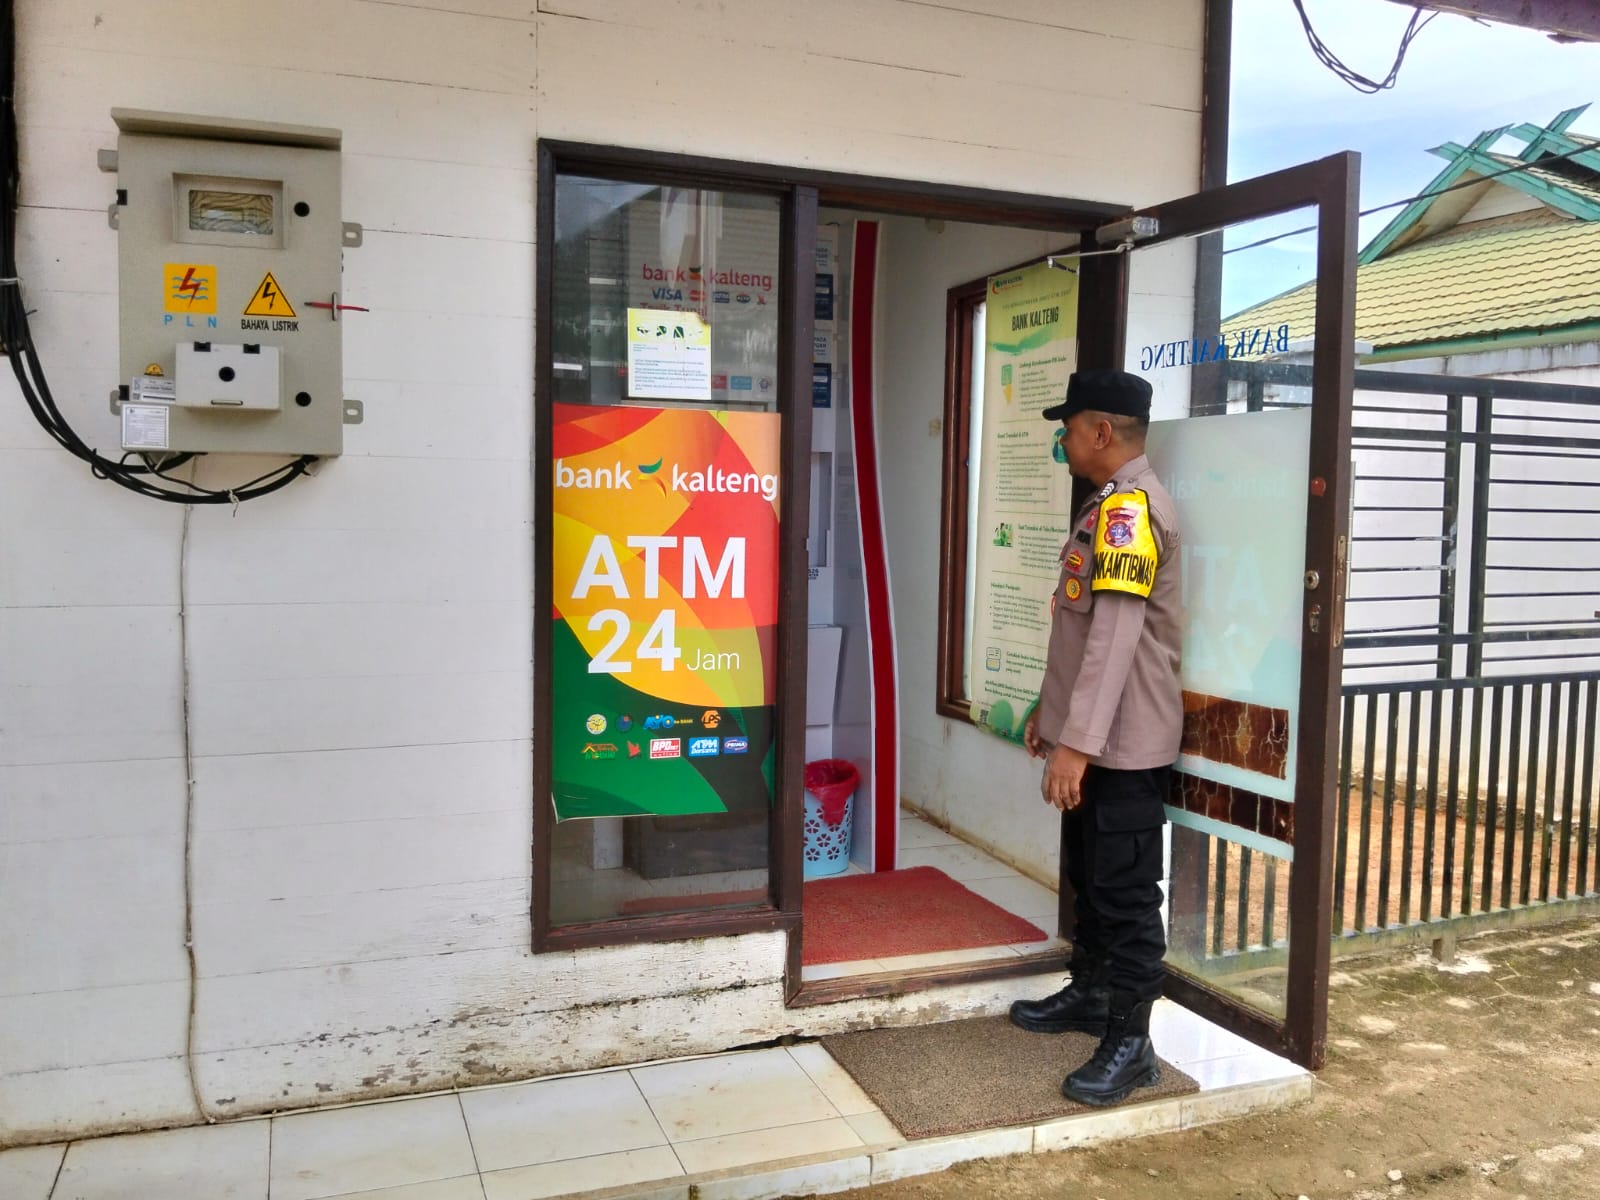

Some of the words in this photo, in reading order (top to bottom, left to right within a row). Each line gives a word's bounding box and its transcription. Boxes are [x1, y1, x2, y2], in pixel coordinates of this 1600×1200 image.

[643, 264, 685, 281] bank
[709, 267, 772, 292] kalteng
[652, 287, 683, 301] VISA
[241, 319, 269, 330] BAHAYA
[272, 320, 299, 332] LISTRIK
[1012, 312, 1028, 332] BANK
[1029, 306, 1059, 328] KALTENG
[555, 458, 633, 490] bank
[672, 463, 778, 502] kalteng
[570, 535, 746, 599] ATM
[586, 608, 681, 674] 24
[686, 648, 740, 671] Jam
[703, 713, 721, 725] LPS
[691, 738, 718, 749] ATM
